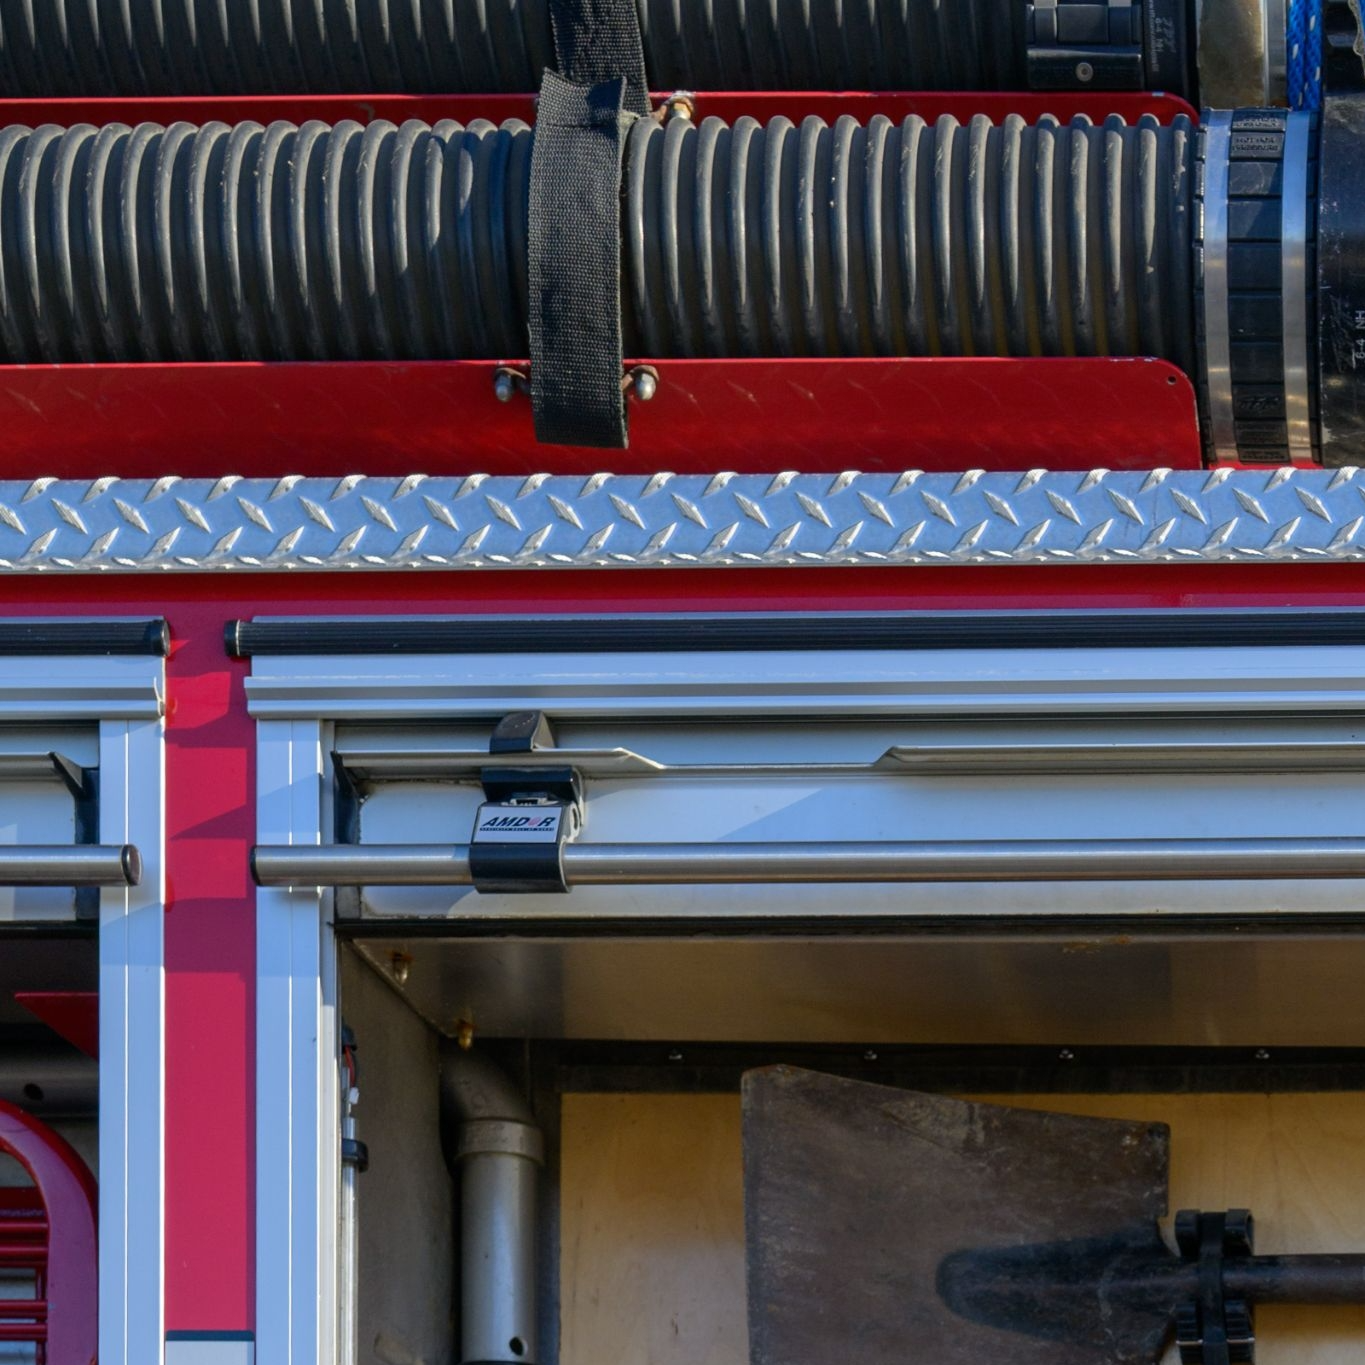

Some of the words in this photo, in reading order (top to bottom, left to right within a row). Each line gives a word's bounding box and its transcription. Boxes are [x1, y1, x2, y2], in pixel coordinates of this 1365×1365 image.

[1354, 310, 1365, 330] NH
[1354, 338, 1365, 360] 6-4
[482, 816, 557, 827] AMDOR
